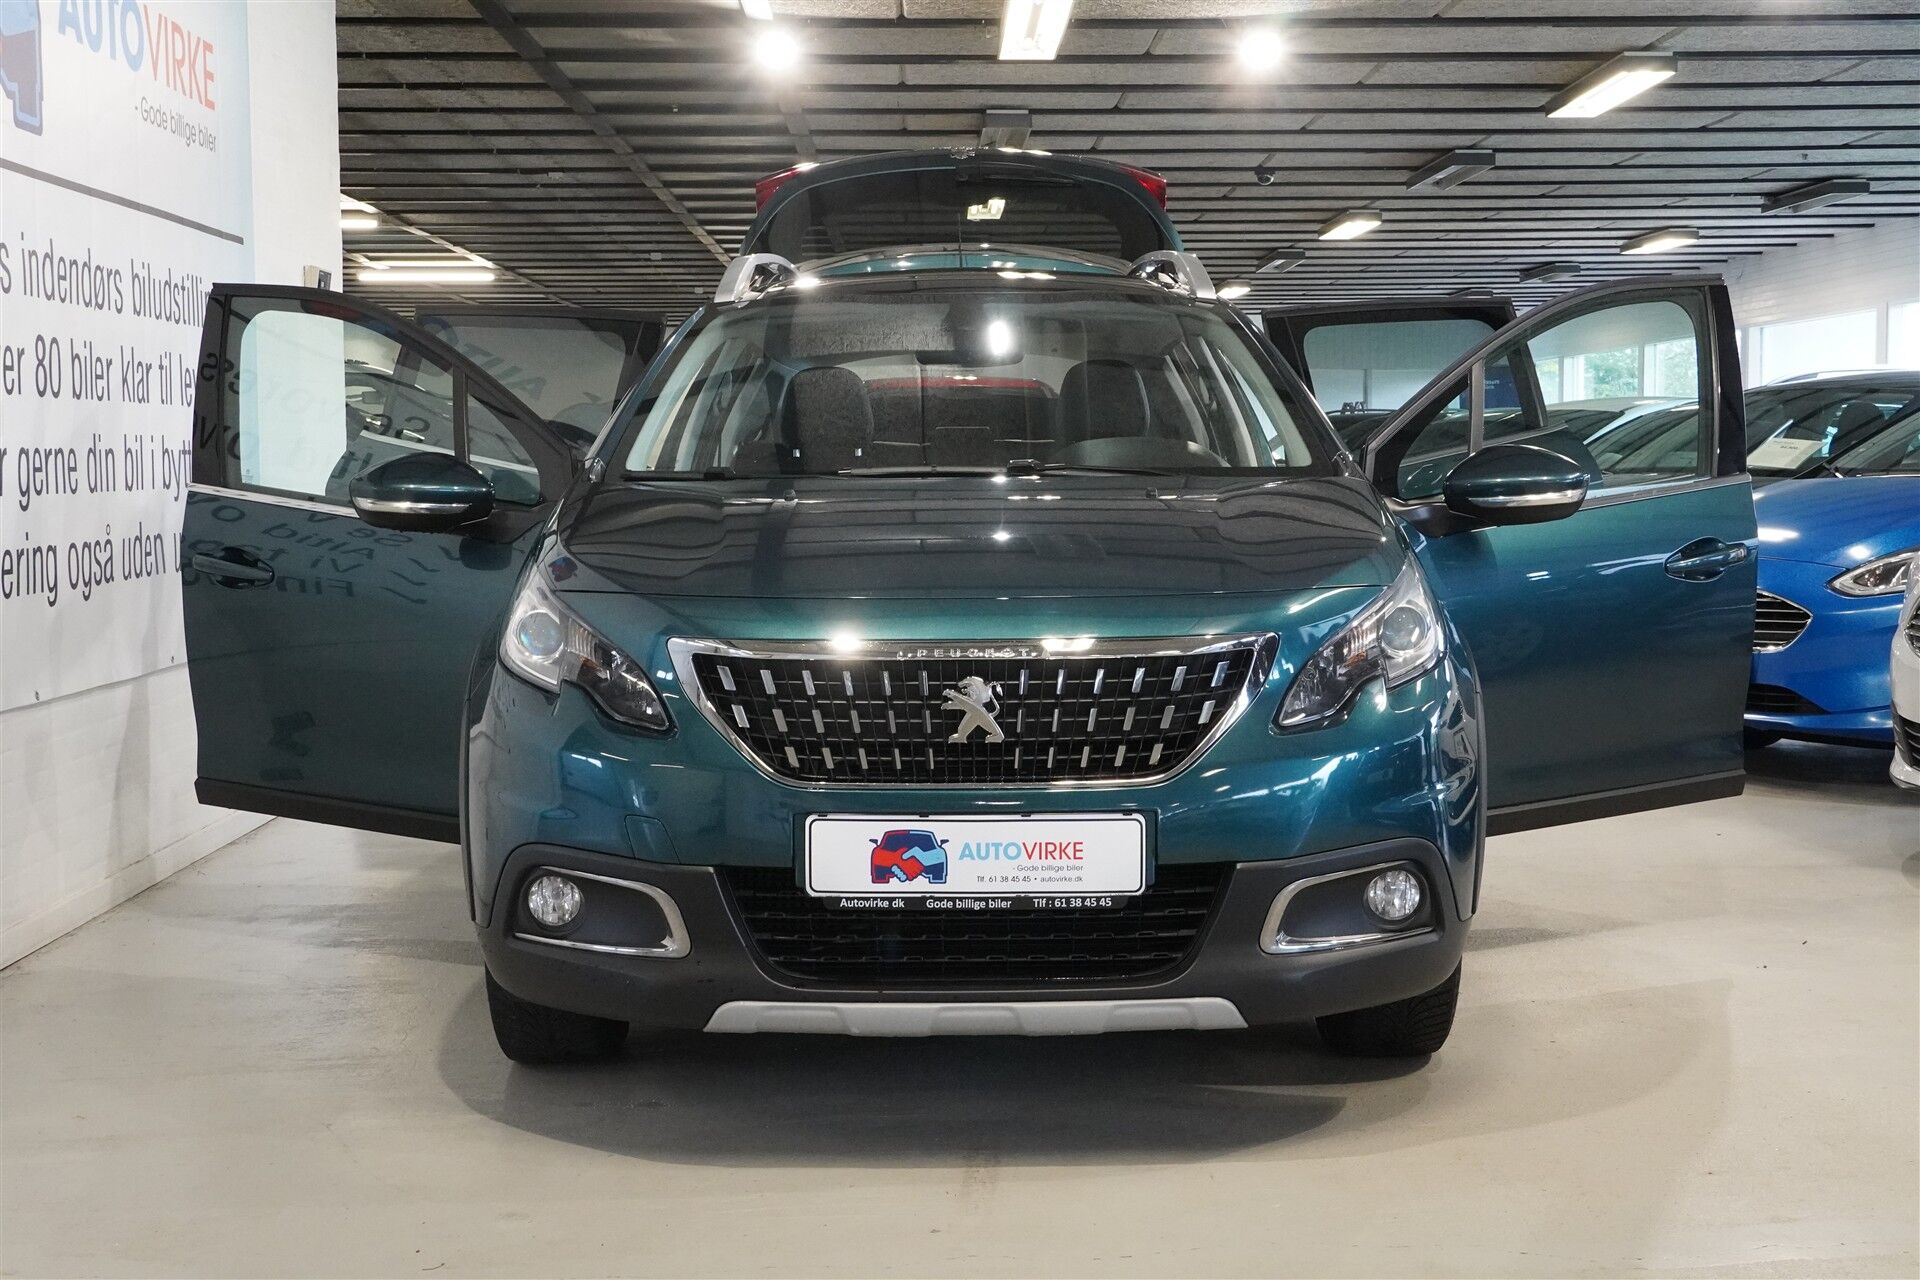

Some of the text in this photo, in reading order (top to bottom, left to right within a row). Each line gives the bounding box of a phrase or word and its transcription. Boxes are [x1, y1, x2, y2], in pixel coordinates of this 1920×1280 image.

[58, 0, 215, 111] AUTOVIRKE
[140, 95, 168, 130] Gode
[169, 108, 197, 147] billige
[198, 123, 217, 153] biler
[21, 231, 124, 315] indendørs
[130, 257, 210, 328] biludstilli
[35, 334, 62, 399] 80
[70, 337, 113, 402] biler
[120, 345, 152, 404] klar
[158, 351, 173, 406] til
[18, 446, 78, 512] gerne
[87, 433, 116, 494] din
[124, 434, 145, 492] bil
[150, 435, 156, 490] i
[1, 532, 58, 608] ering
[68, 523, 115, 602] også
[122, 521, 167, 582] uden
[958, 841, 1084, 861] AUTOVIRKE
[988, 875, 997, 883] 61
[1000, 875, 1009, 883] 38
[1010, 875, 1020, 883] 45
[1022, 875, 1032, 883] 45
[1016, 864, 1039, 872] Gode
[1041, 864, 1065, 873] billige
[1066, 864, 1084, 872] biler
[840, 898, 889, 908] Autovirke
[892, 898, 905, 908] dk
[926, 899, 953, 908] Gode
[955, 899, 986, 911] billige
[988, 899, 1012, 908] biler
[1033, 898, 1047, 908] Tlf
[1054, 898, 1067, 908] 61
[1069, 898, 1082, 908] 38
[1084, 898, 1097, 907] 45
[1099, 897, 1112, 907] 45
